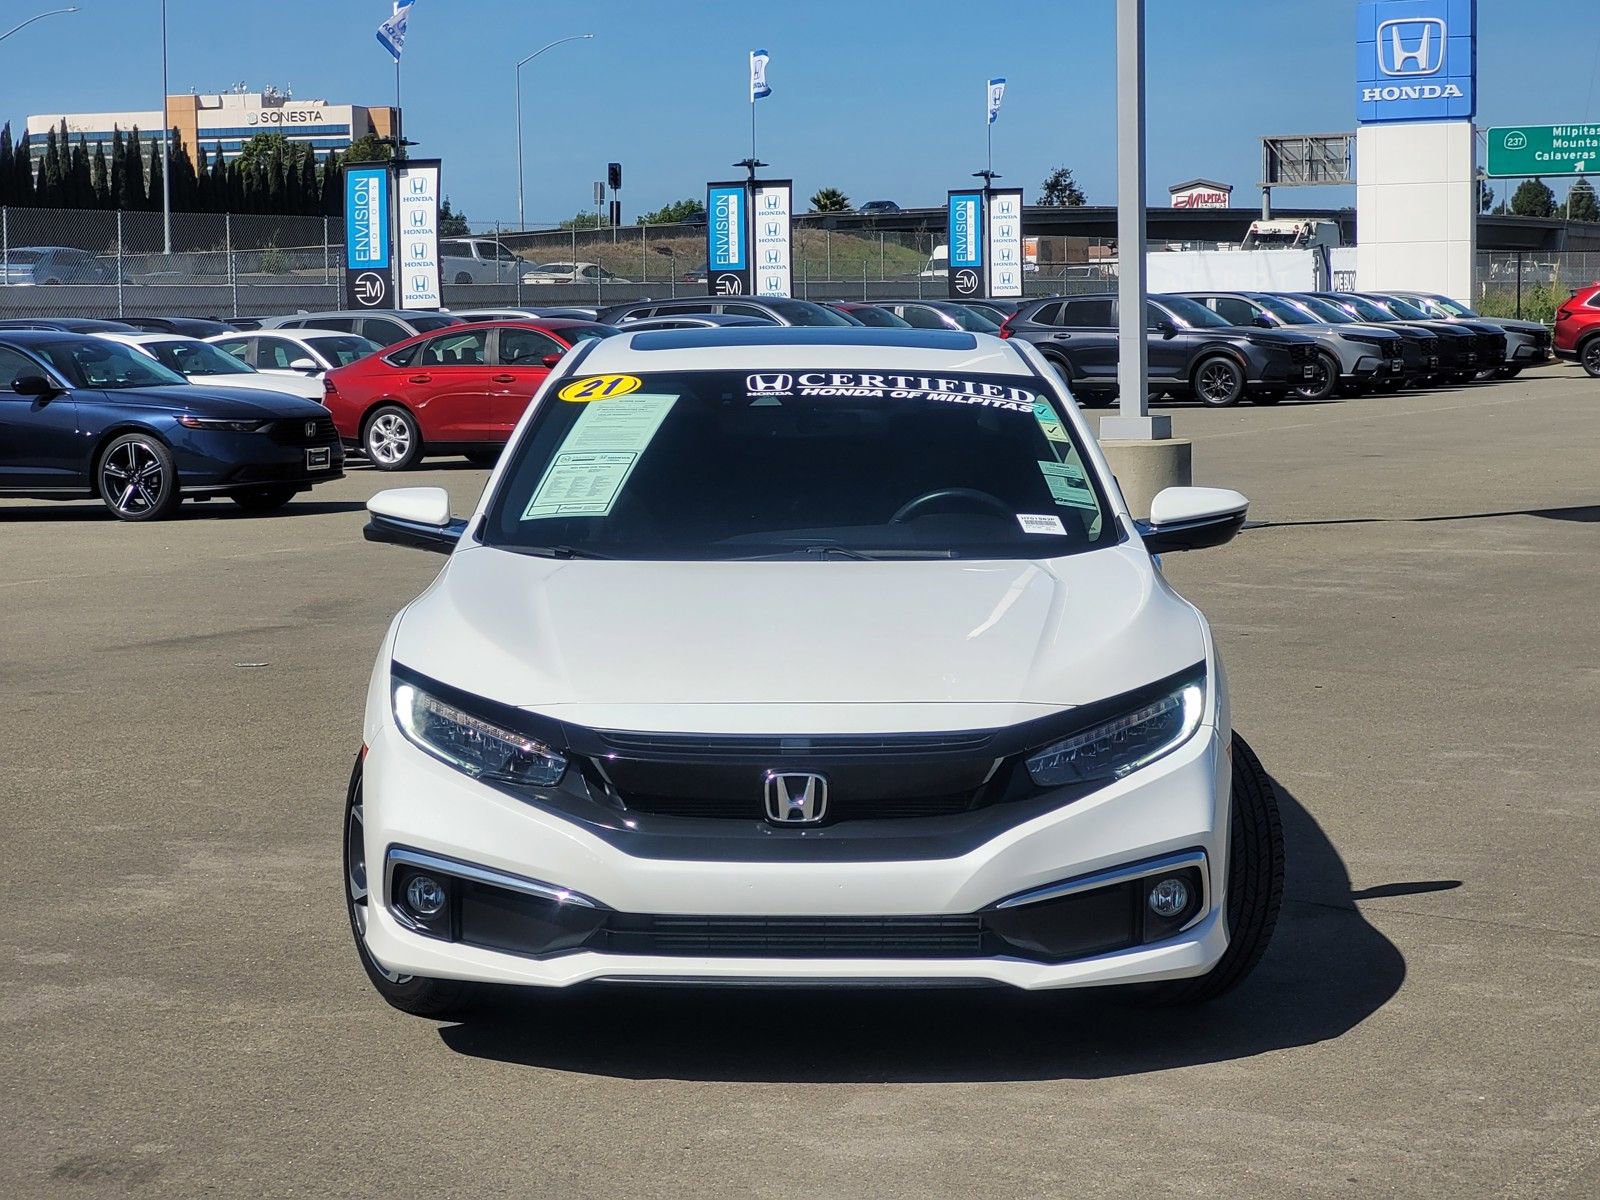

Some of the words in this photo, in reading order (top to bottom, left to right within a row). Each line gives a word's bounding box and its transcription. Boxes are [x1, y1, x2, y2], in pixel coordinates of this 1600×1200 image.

[1362, 84, 1463, 102] HONDA
[260, 110, 323, 124] SONESTA
[1508, 137, 1523, 147] 237
[1535, 151, 1596, 161] Calaveras
[355, 177, 369, 261] ENVISION
[716, 195, 729, 264] ENVISION
[956, 200, 967, 262] ENVISION
[574, 378, 625, 399] 21
[798, 373, 1036, 403] CERTIFIED
[801, 387, 883, 398] HONDA
[890, 388, 924, 399] OF
[925, 392, 1035, 413] MILPITAS
